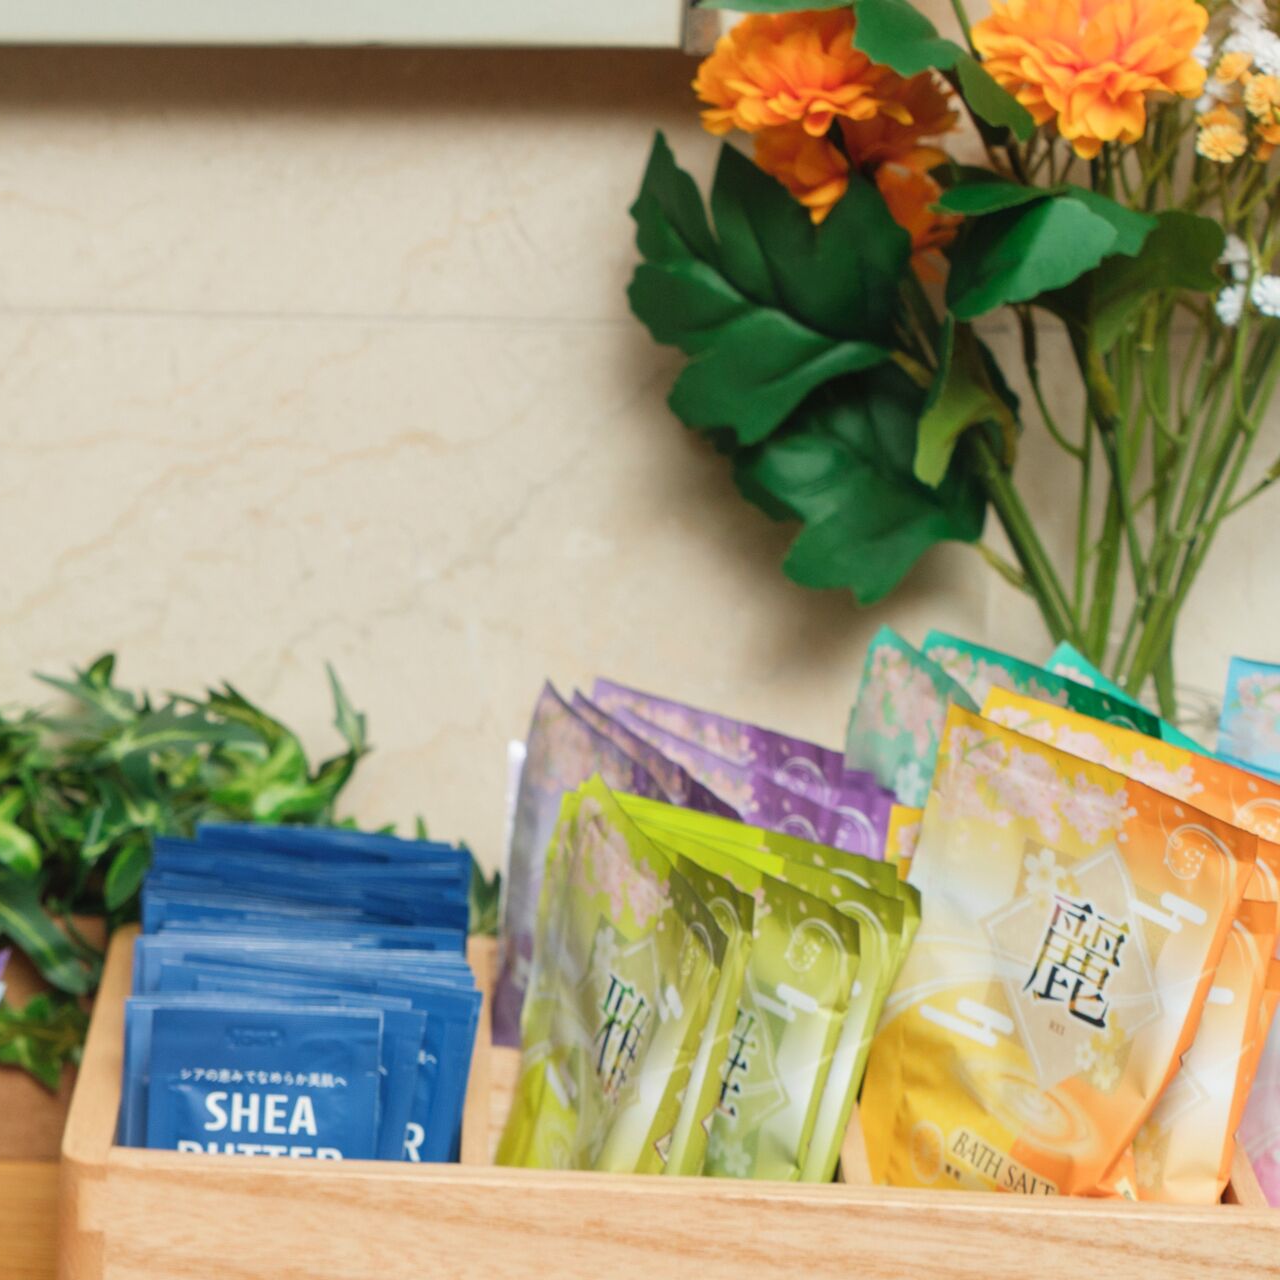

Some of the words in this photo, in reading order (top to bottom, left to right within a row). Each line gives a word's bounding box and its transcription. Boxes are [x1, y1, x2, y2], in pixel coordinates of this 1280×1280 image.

[1023, 894, 1130, 1028] 麗
[204, 1091, 318, 1136] SHEA
[951, 1131, 1003, 1179] BATH
